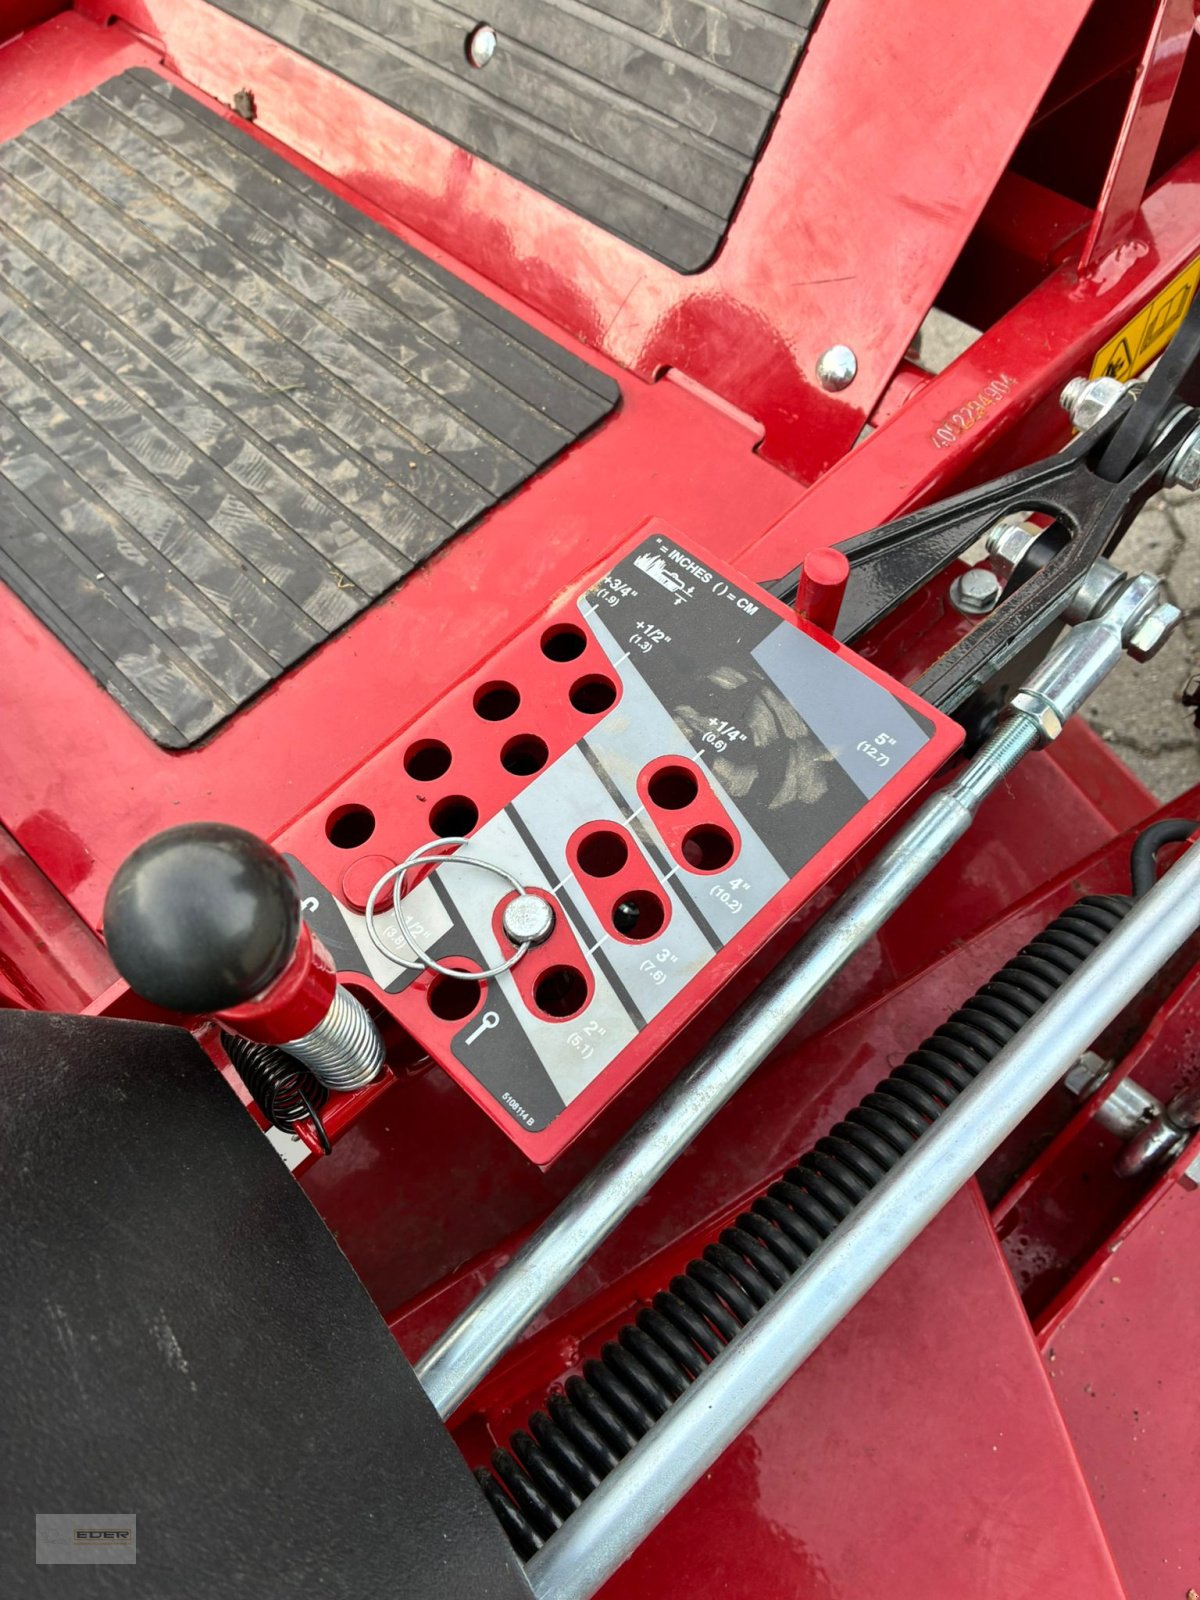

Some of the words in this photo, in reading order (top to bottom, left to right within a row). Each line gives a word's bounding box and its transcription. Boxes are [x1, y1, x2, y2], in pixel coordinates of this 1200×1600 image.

[604, 576, 639, 597] +3/4"
[668, 549, 713, 583] INCHES
[736, 598, 760, 616] CM
[597, 588, 620, 607] (1.9)
[636, 621, 672, 643] +1/2"
[629, 634, 653, 653] (1.3)
[708, 717, 748, 742] +1/4"
[874, 732, 897, 745] 5"
[701, 731, 728, 753] (0.6)
[856, 740, 890, 767] (12.7)
[728, 878, 752, 890] 4"
[709, 884, 743, 914] (10.2)
[656, 948, 679, 963] 3"
[639, 959, 667, 985] (7.6)
[583, 1020, 607, 1036] 2"
[566, 1032, 594, 1060] (5.1)
[502, 1092, 529, 1120] 5108114
[526, 1117, 535, 1126] B
